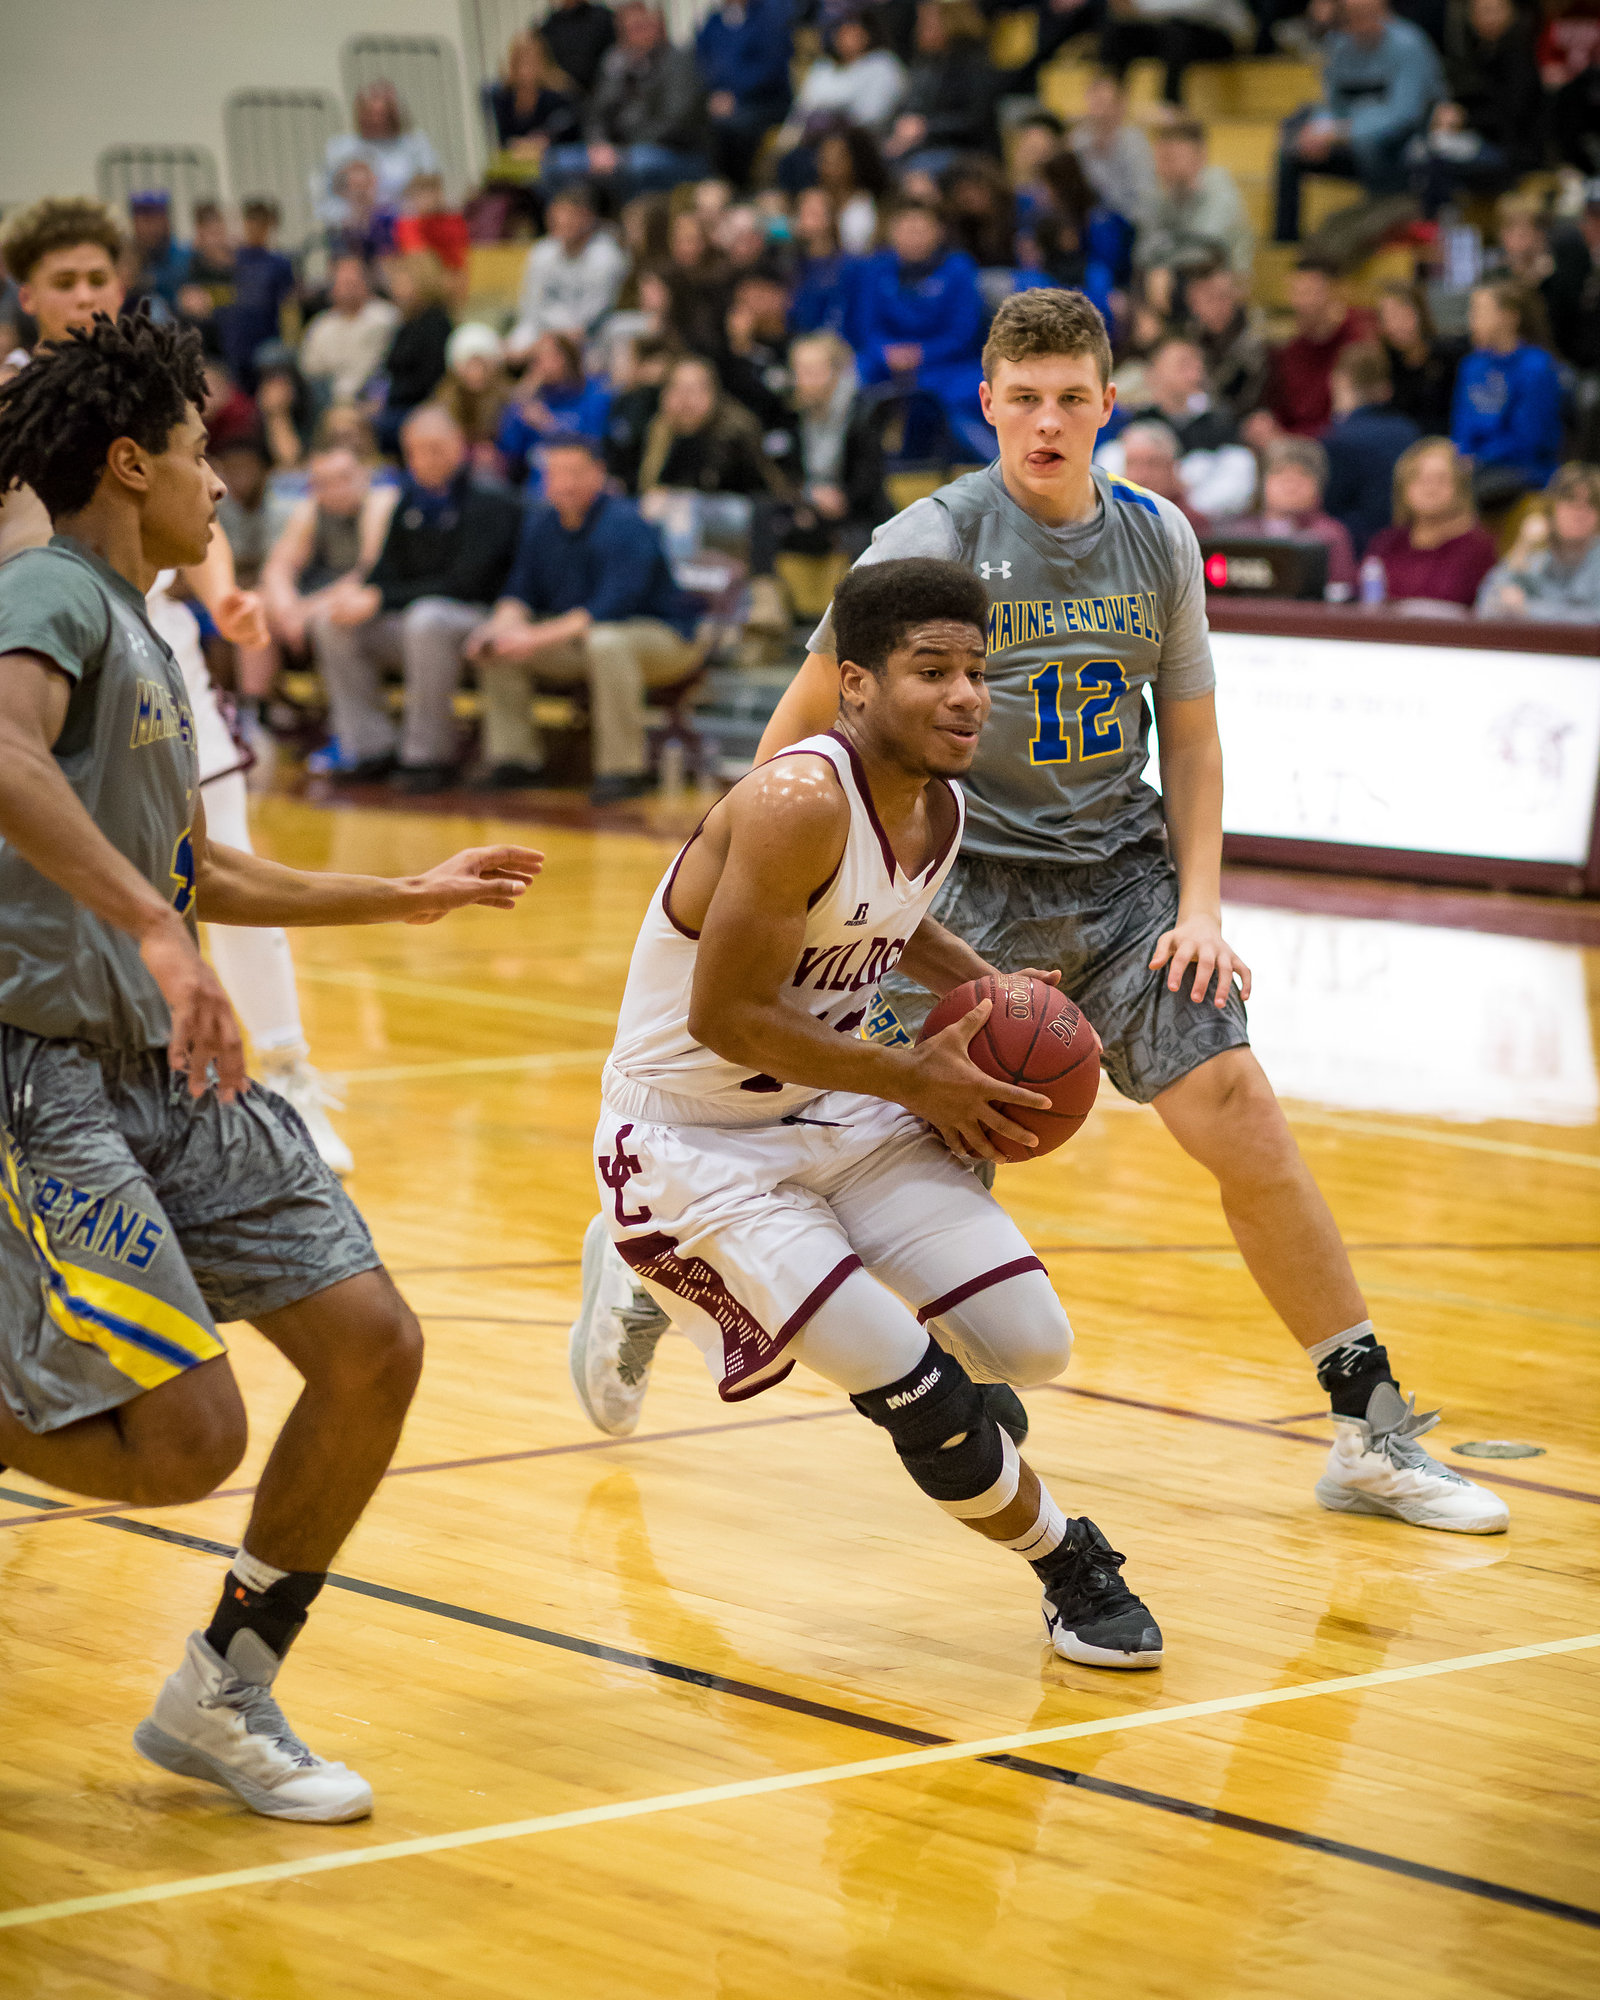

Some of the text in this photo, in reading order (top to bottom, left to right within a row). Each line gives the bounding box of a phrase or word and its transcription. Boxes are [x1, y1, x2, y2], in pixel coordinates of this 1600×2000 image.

[985, 591, 1161, 657] MAINE ENDWELL
[1028, 659, 1130, 766] 12
[1008, 973, 1031, 1020] 000
